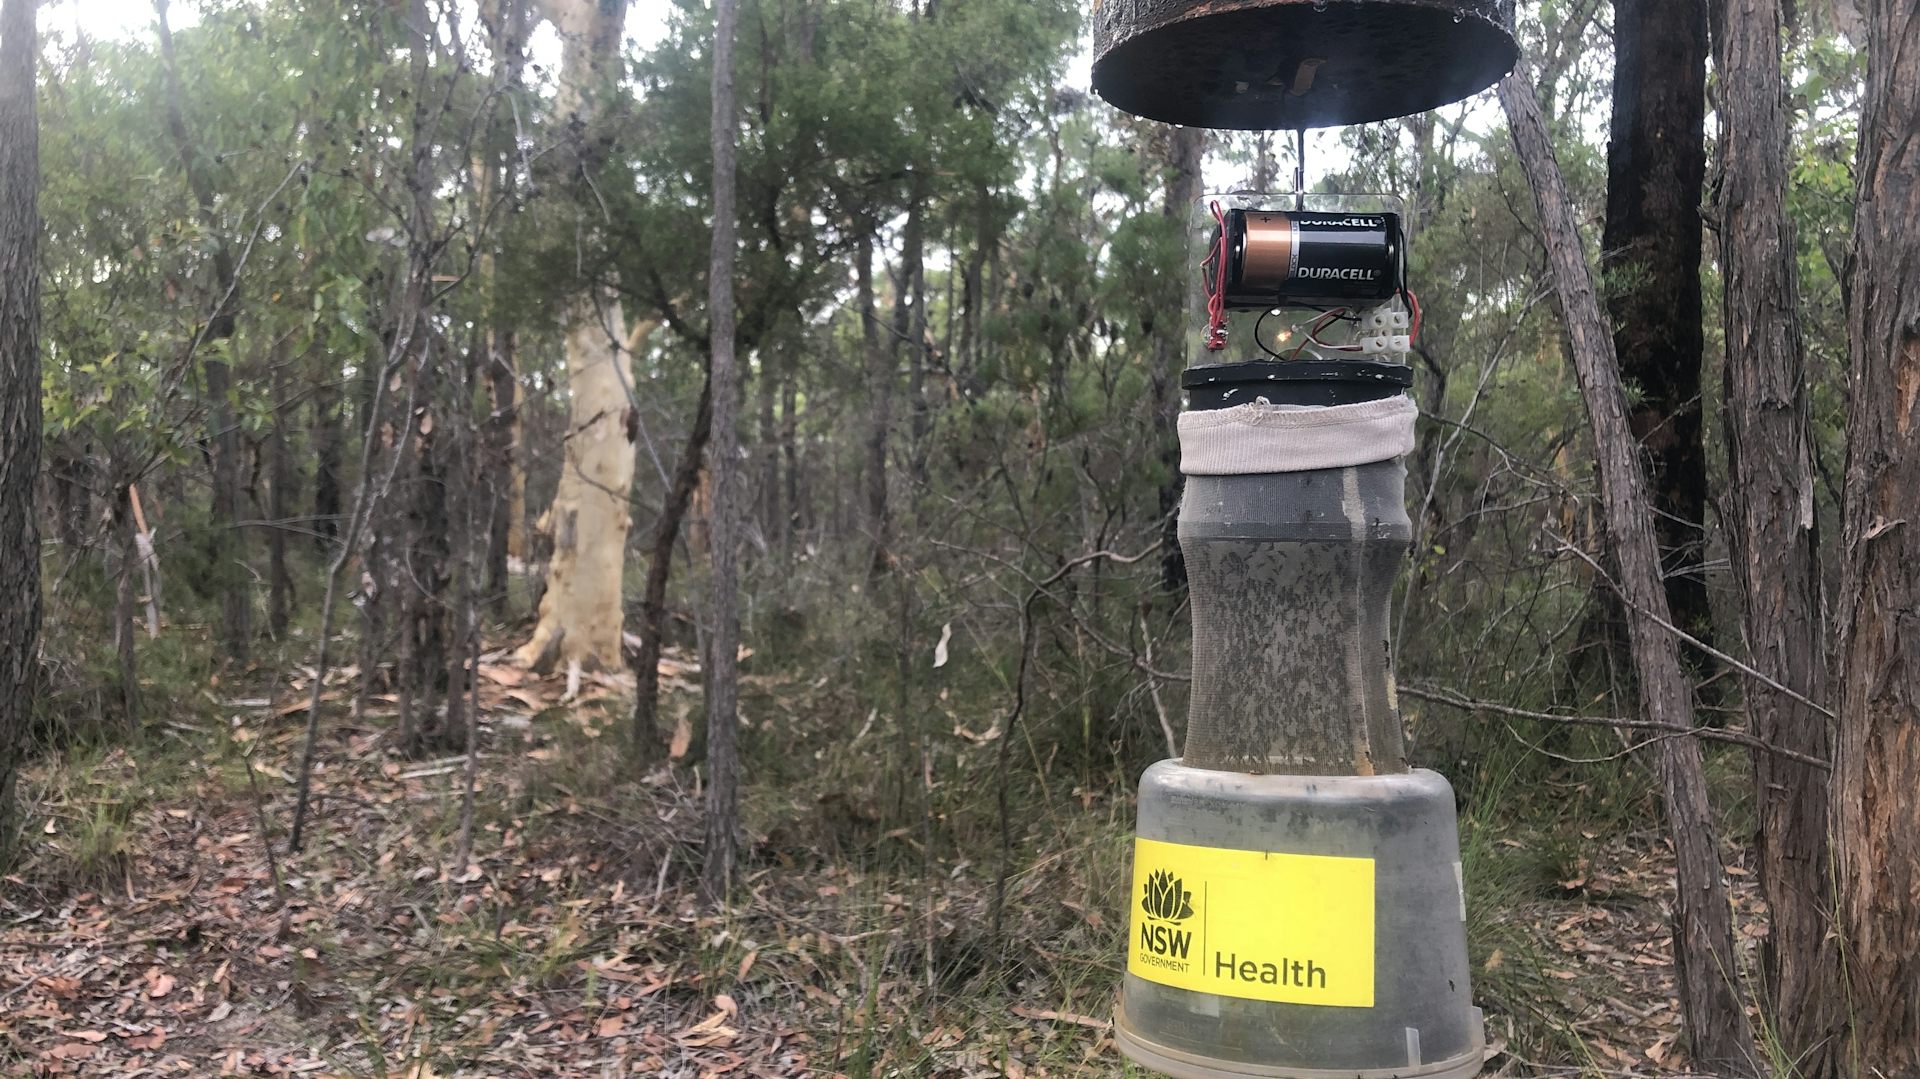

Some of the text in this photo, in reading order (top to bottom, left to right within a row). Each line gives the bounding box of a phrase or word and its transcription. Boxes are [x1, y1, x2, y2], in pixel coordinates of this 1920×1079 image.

[1297, 267, 1374, 280] DURACELL
[1140, 922, 1192, 960] NSW
[1139, 952, 1191, 973] GOVERNMENT
[1215, 951, 1327, 989] Health
